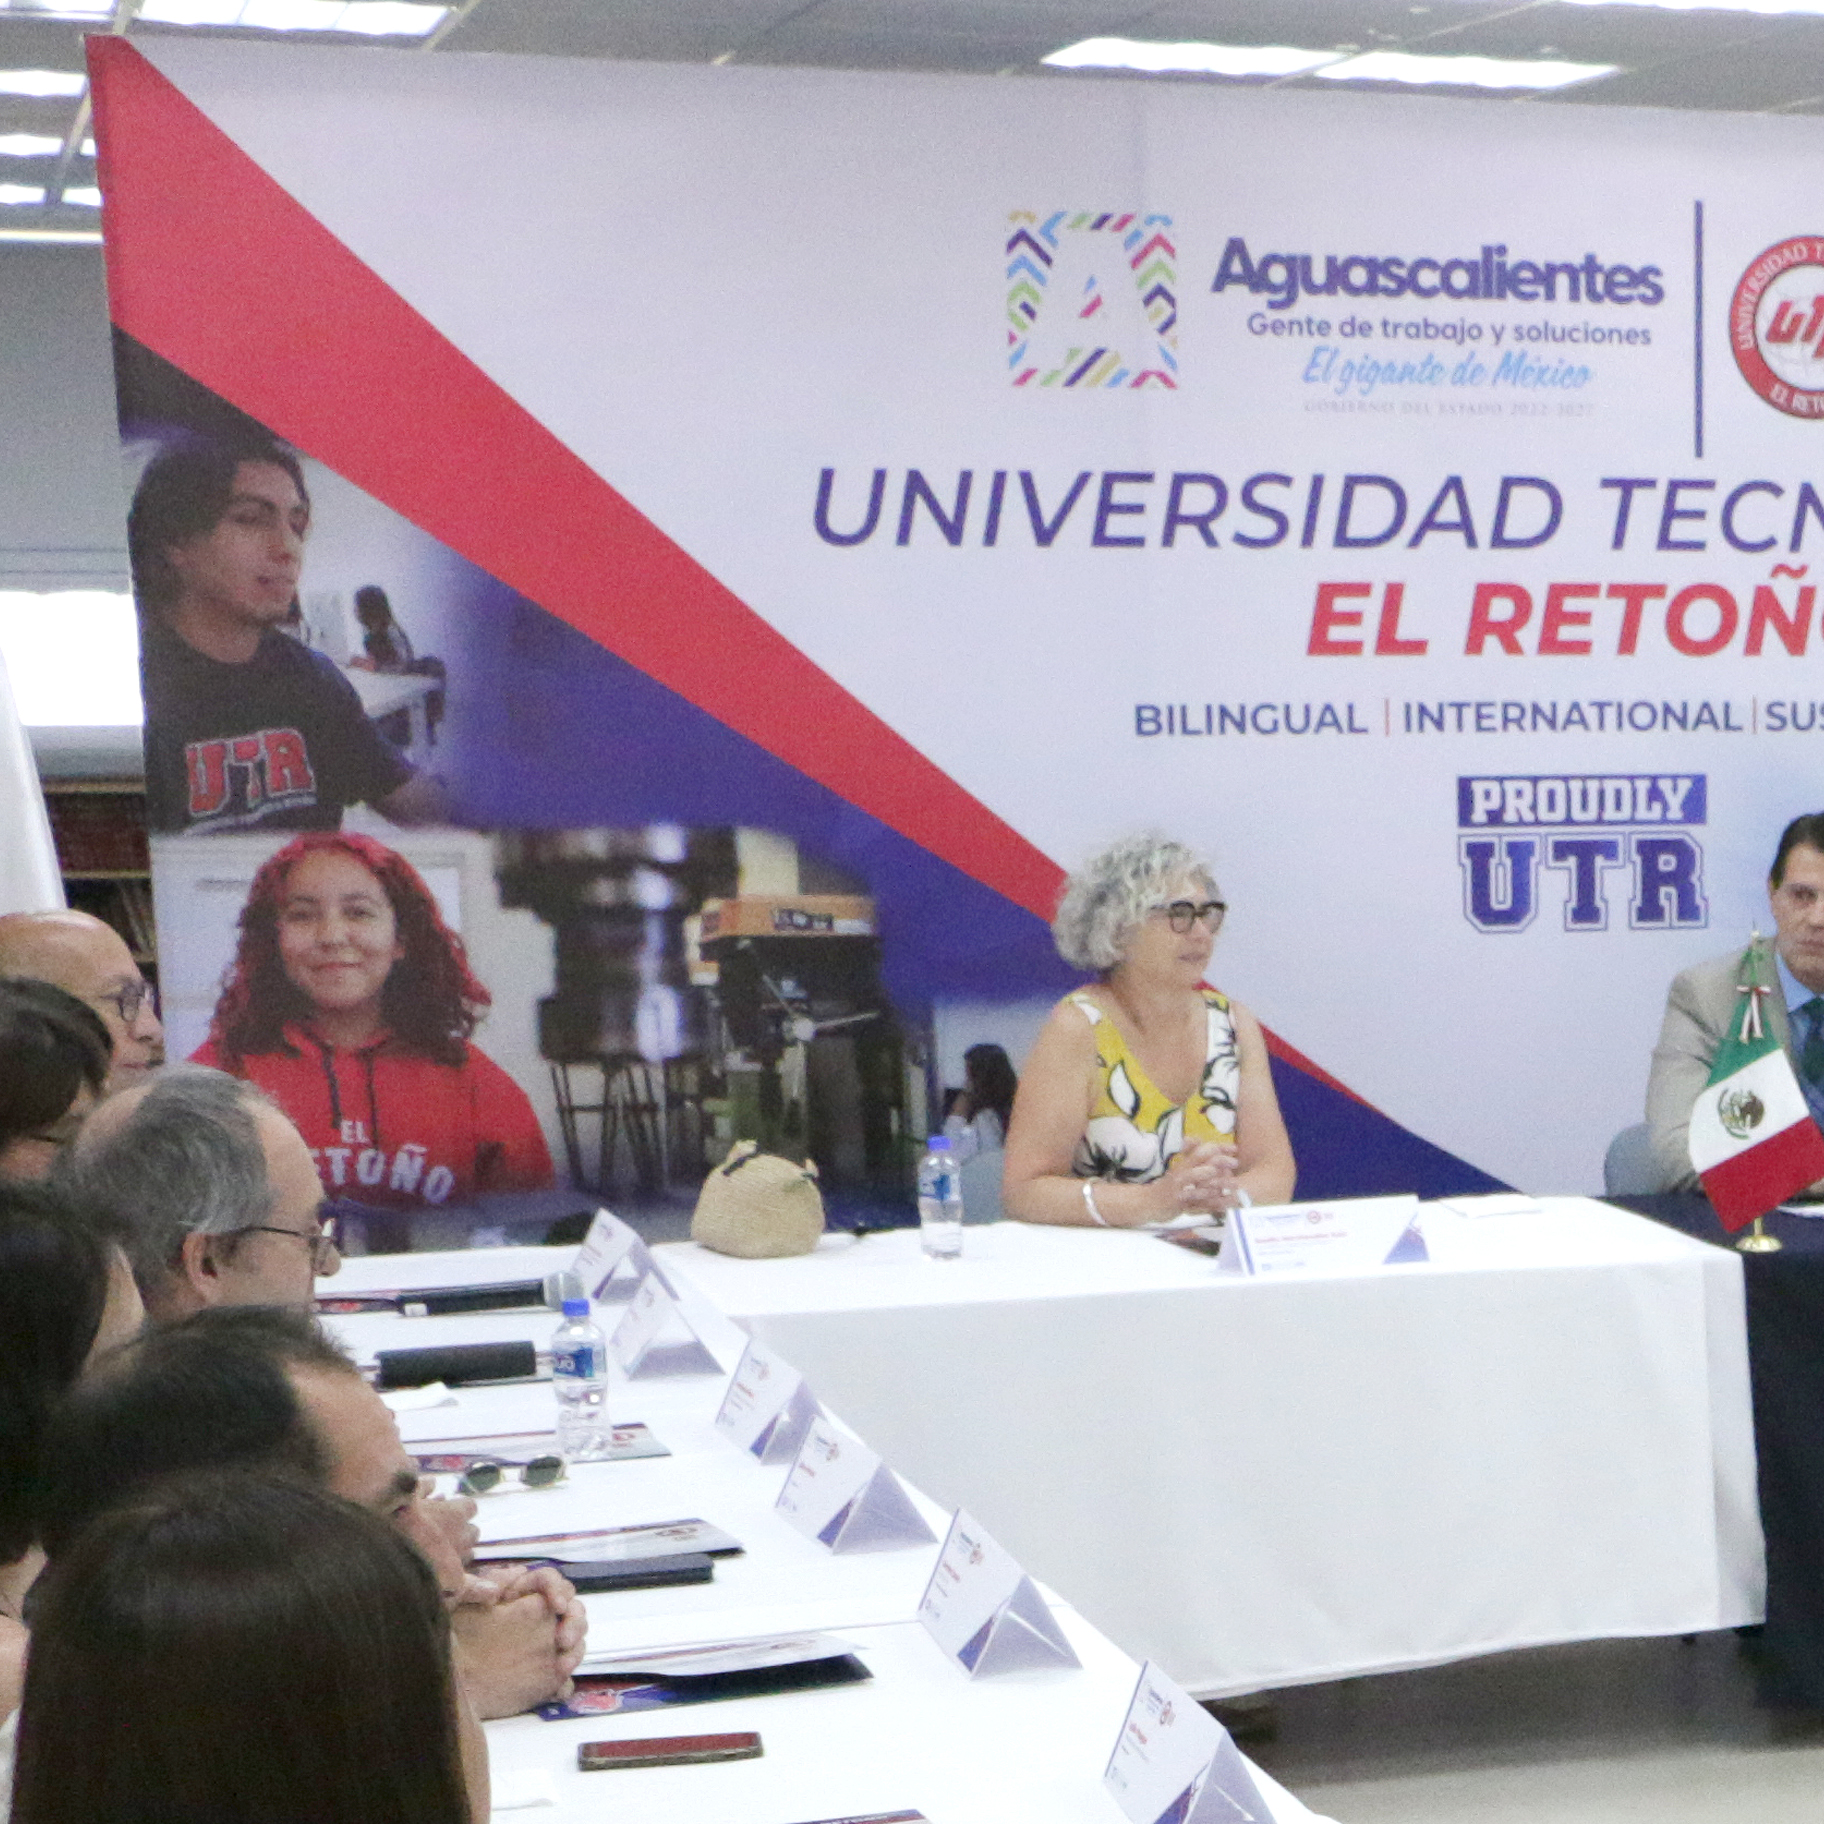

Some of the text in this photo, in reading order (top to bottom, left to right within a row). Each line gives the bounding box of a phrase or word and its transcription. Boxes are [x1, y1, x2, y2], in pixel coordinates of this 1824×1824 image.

[1212, 237, 1665, 310] Aguascalientes
[1247, 312, 1652, 346] Gente de trabajo y soluciones
[1302, 346, 1592, 396] El gigante de México
[812, 468, 1564, 550] UNIVERSIDAD
[1306, 582, 1431, 657] EL
[1133, 702, 1368, 737] BILINGUAL
[1402, 700, 1745, 736] INTERNATIONAL
[1470, 776, 1694, 823] PROUDLY
[1459, 833, 1709, 934] UTR
[340, 1119, 370, 1144] EL
[310, 1143, 456, 1204] TOÑO
